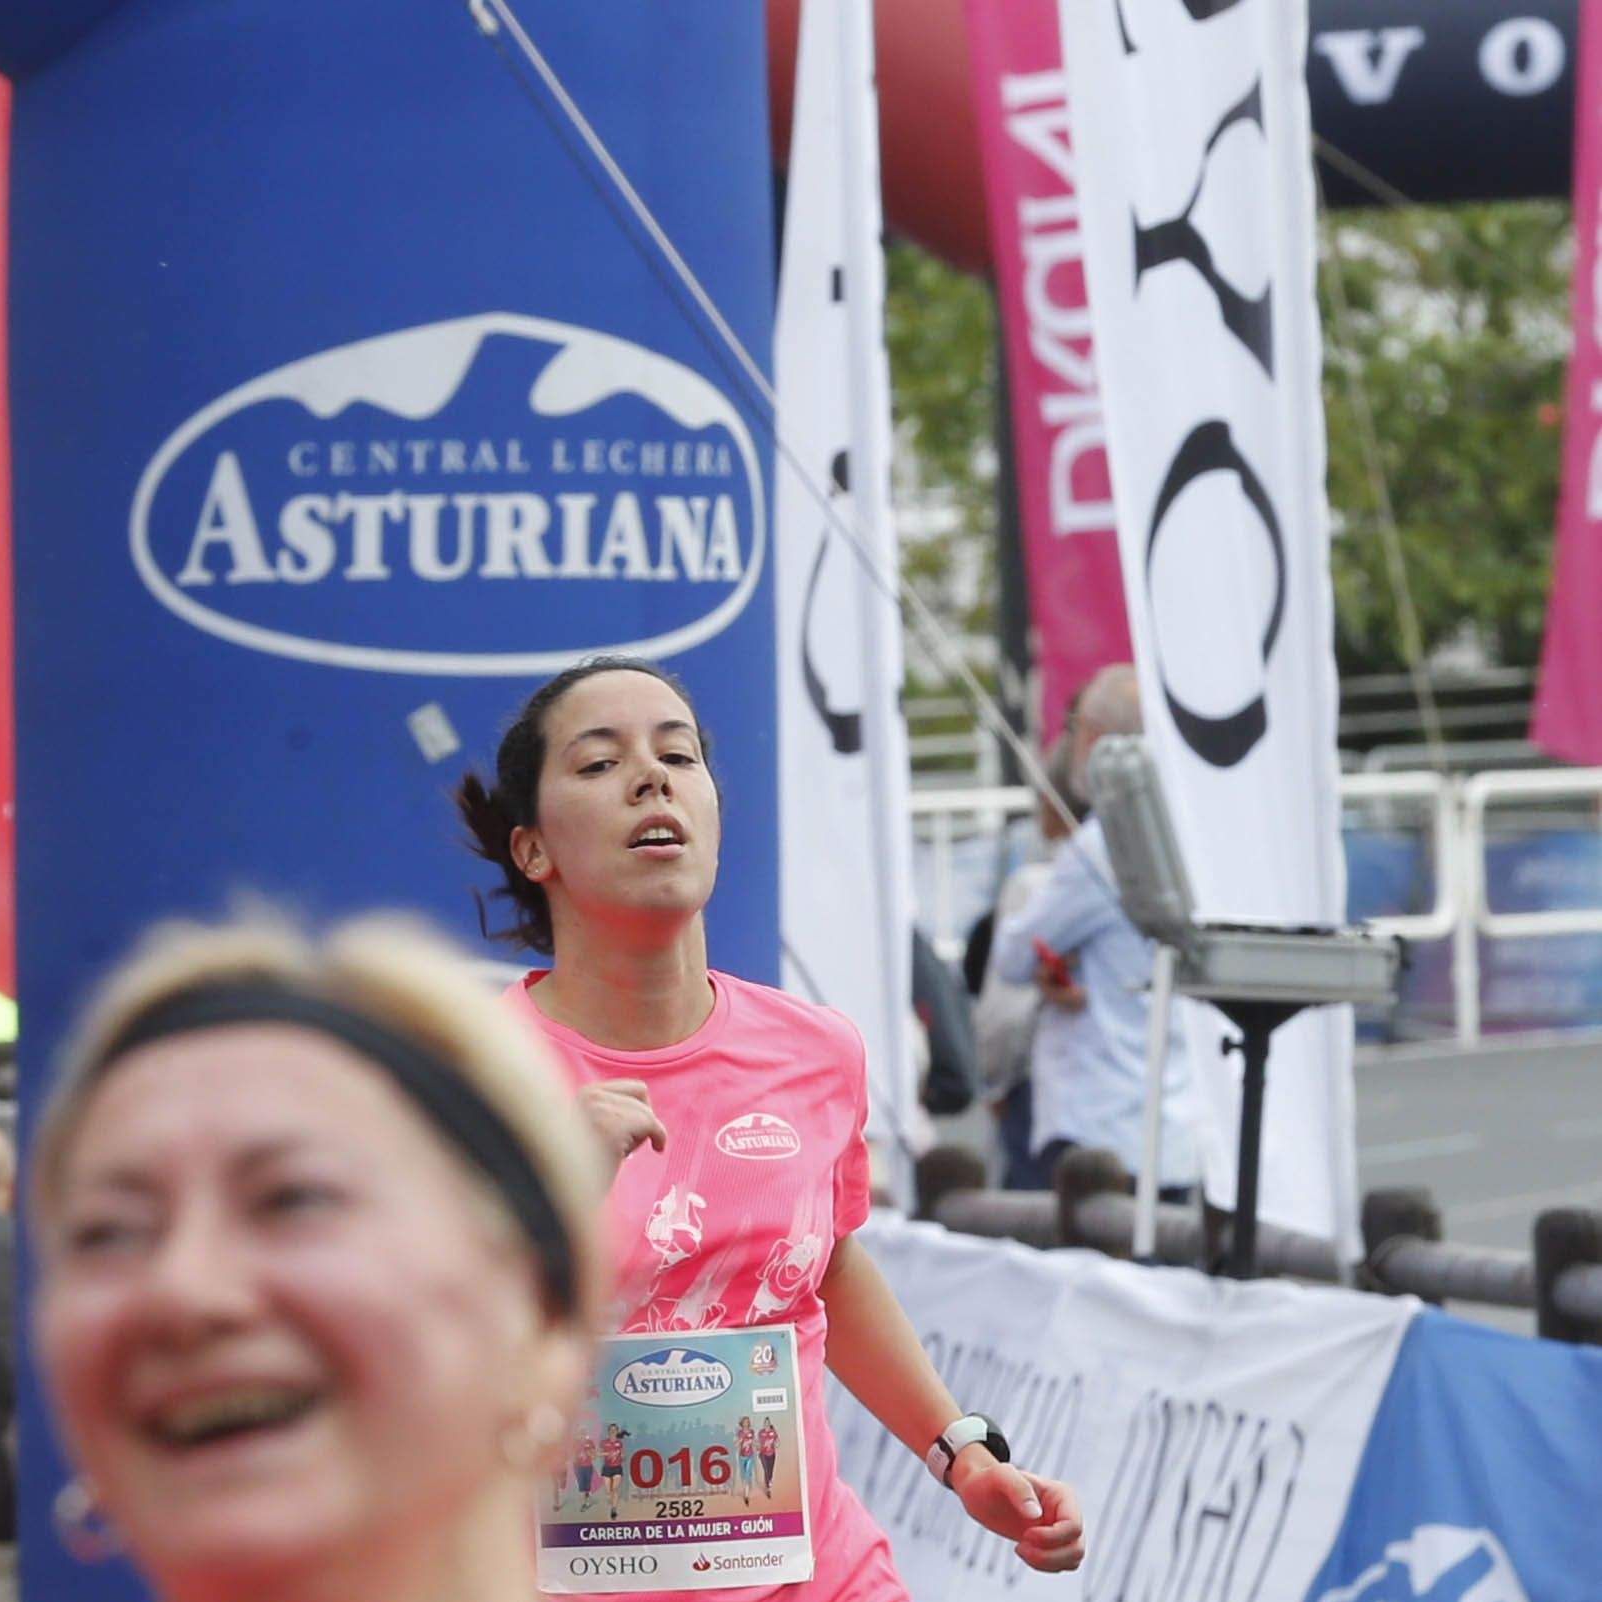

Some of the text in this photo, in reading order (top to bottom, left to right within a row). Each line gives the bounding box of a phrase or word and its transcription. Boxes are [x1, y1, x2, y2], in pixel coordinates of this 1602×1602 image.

[287, 438, 733, 479] CENTRAL LECHERA
[753, 1344, 773, 1364] 20
[623, 1371, 726, 1395] ASTURIANA
[628, 1445, 732, 1490] 016
[655, 1499, 705, 1519] 2582
[579, 1526, 642, 1542] CARRERA
[645, 1525, 663, 1539] DE
[667, 1524, 685, 1538] LA
[688, 1521, 731, 1538] MUJER
[741, 1516, 774, 1536] GIJÓN
[569, 1554, 659, 1579] OYSHO
[712, 1550, 785, 1571] Santander
